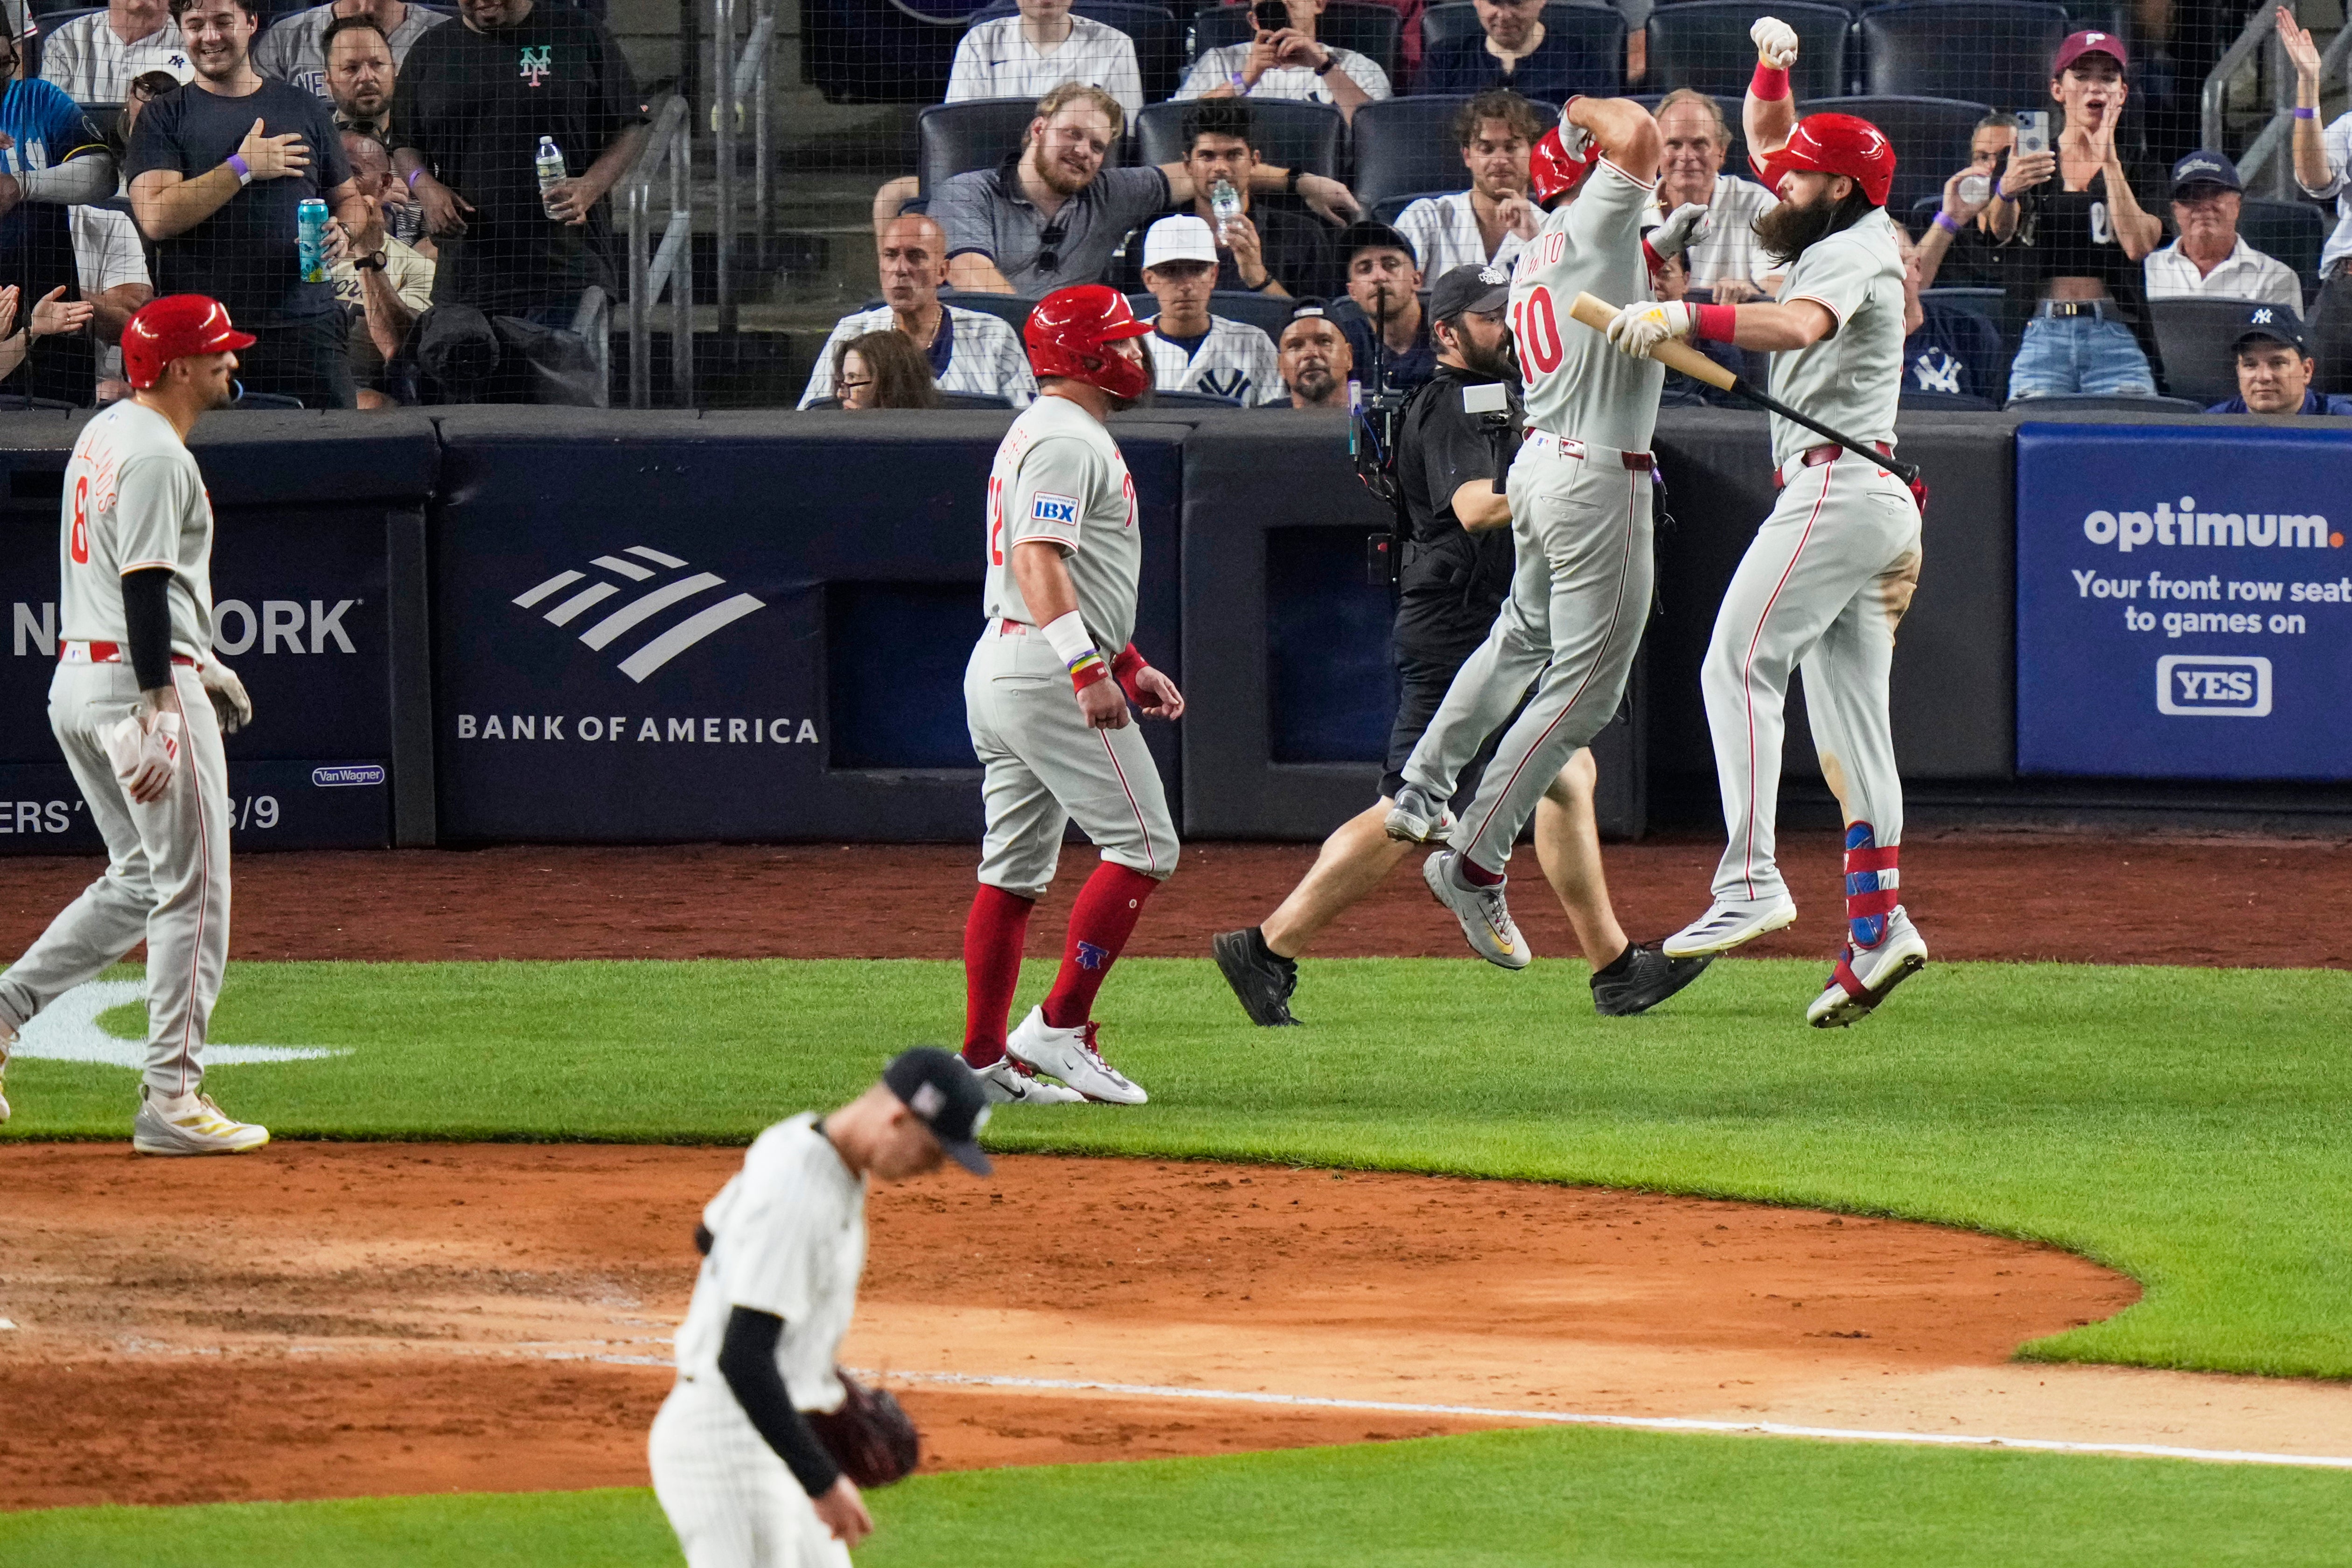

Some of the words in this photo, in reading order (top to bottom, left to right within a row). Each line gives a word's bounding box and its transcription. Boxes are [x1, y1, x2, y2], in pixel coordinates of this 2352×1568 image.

[520, 45, 551, 87] NY
[2251, 308, 2273, 324] NY
[1514, 286, 1564, 384] 10
[1913, 353, 1963, 394] NY
[71, 476, 89, 564] 8
[1035, 501, 1075, 523] IBX
[2072, 570, 2142, 599] Your
[2148, 571, 2221, 600] front
[2228, 581, 2284, 601] row
[2290, 577, 2352, 602] seat
[2125, 606, 2157, 631] to
[2163, 612, 2262, 638] games
[2269, 614, 2306, 634] on
[2176, 671, 2252, 701] YES
[458, 714, 565, 740] BANK
[577, 716, 626, 741] OF
[637, 717, 819, 744] AMERICA
[319, 771, 339, 781] Van
[340, 770, 381, 782] Wagner
